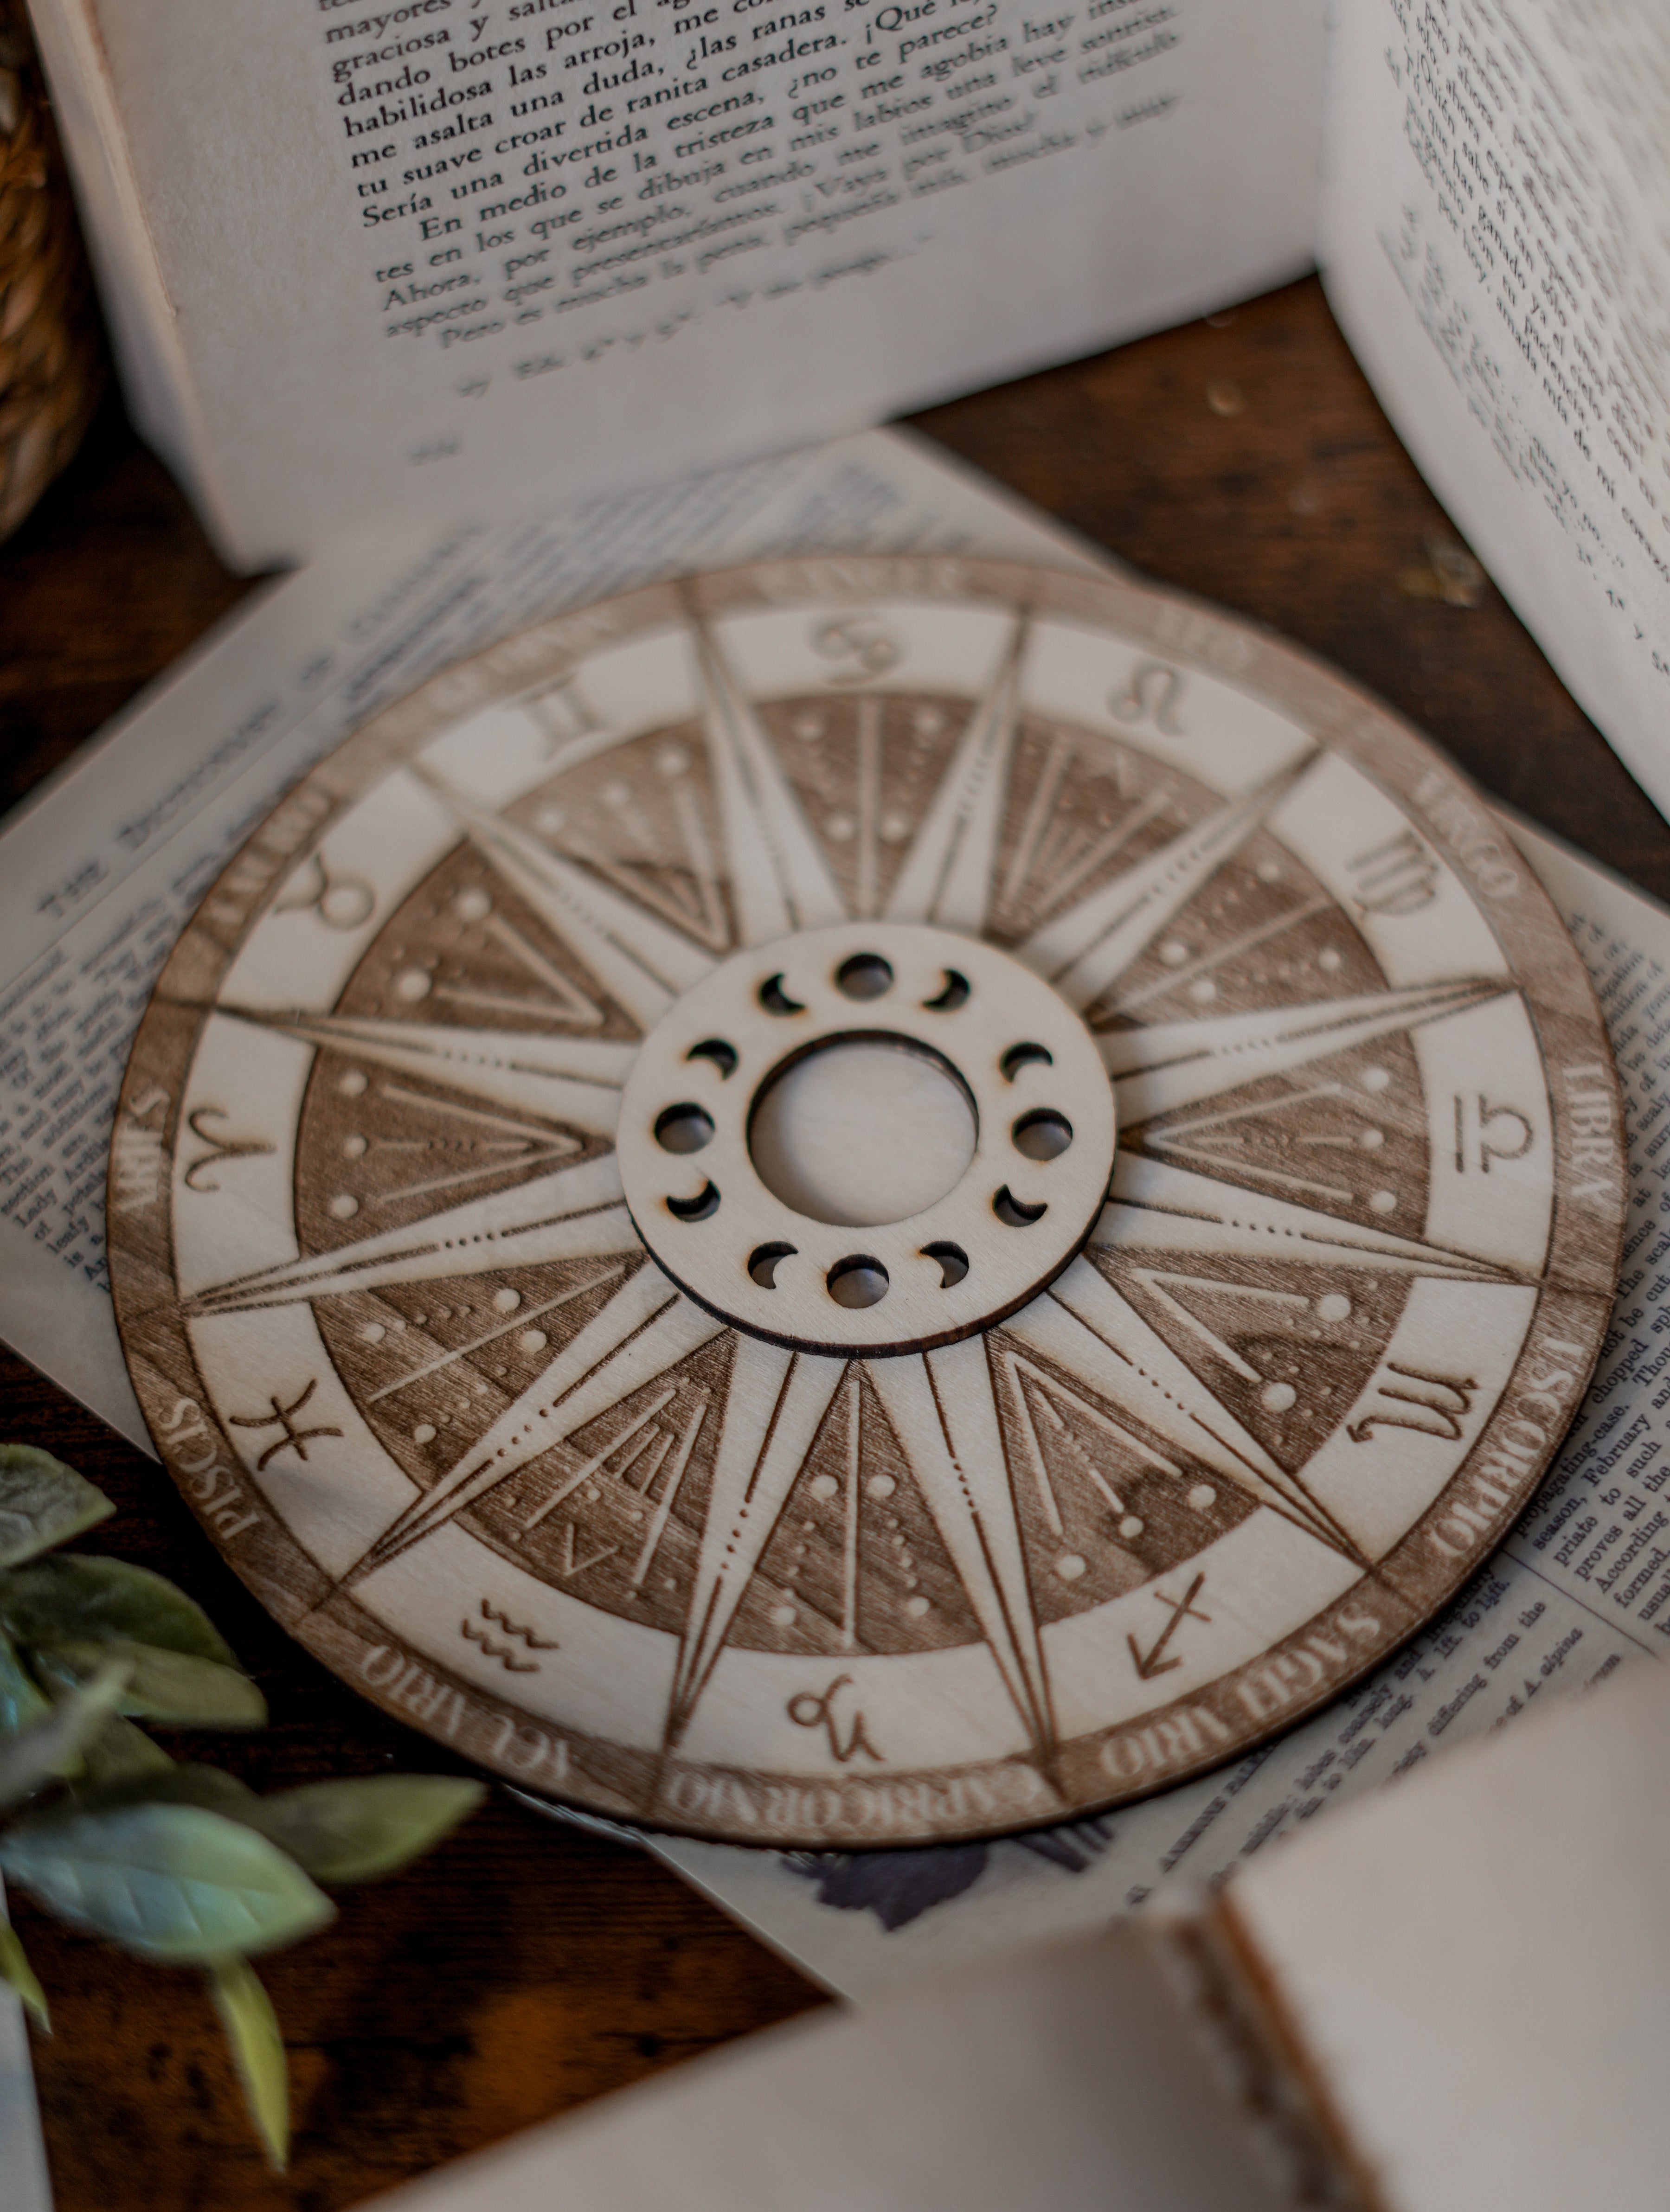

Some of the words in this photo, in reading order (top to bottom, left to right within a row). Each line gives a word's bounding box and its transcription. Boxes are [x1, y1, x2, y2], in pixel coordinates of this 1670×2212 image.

[325, 0, 451, 44] mayores
[332, 29, 451, 83] graciosa
[469, 15, 488, 42] y
[337, 65, 430, 106] dando
[448, 38, 526, 72] botes
[546, 16, 594, 51] por
[613, 0, 636, 20] el
[343, 81, 493, 137] habilidosa
[509, 64, 547, 87] las
[565, 30, 655, 69] arroja,
[674, 8, 718, 34] me
[352, 145, 396, 168] me
[415, 113, 493, 149] asalta
[510, 91, 564, 116] una
[583, 59, 664, 95] duda,
[686, 35, 737, 70] ¿las
[752, 6, 825, 40] ranas
[357, 179, 388, 197] tu
[404, 148, 482, 185] suave
[495, 122, 566, 154] croar
[580, 104, 613, 128] de
[627, 78, 708, 113] ranita
[721, 35, 847, 82] casadera.
[363, 193, 432, 227] Sería
[451, 173, 503, 199] una
[523, 124, 648, 176] divertida
[667, 91, 764, 130] escena,
[788, 67, 837, 99] ¿no
[855, 51, 880, 70] te
[899, 3, 997, 64] parece?
[419, 217, 462, 241] En
[479, 182, 566, 222] medio
[584, 166, 617, 188] de
[633, 152, 657, 172] la
[674, 116, 774, 158] tristeza
[792, 94, 845, 126] que
[861, 75, 903, 99] me
[920, 35, 1015, 82] agobia
[1022, 15, 1074, 43] hay
[375, 263, 414, 282] tes
[429, 248, 462, 266] en
[475, 231, 515, 252] los
[529, 209, 582, 241] que
[597, 197, 623, 214] se
[637, 160, 726, 200] dibuja
[739, 147, 772, 165] en
[789, 124, 839, 152] mis
[853, 96, 932, 131] labios
[946, 73, 996, 100] una
[383, 274, 480, 311] Ahora,
[503, 249, 550, 281] por
[712, 160, 816, 204] cuando
[838, 143, 880, 165] me
[386, 298, 488, 337] aspecto
[502, 275, 555, 307] que
[1478, 205, 1526, 290] ganado
[1570, 364, 1603, 421] cielo
[1497, 297, 1537, 373] amada
[1562, 1065, 1615, 1198] LIBRA
[12, 1189, 58, 1230] Lady
[46, 1216, 90, 1255] leafy
[64, 1251, 84, 1268] is
[1618, 1308, 1643, 1327] be
[1640, 1275, 1670, 1302] cut
[1591, 1338, 1649, 1404] chopped
[158, 1395, 260, 1540] PISCIS
[1430, 1337, 1586, 1557] ESCORPIO
[1532, 1493, 1588, 1552] season,
[1581, 1412, 1651, 1487] February
[1553, 1516, 1598, 1568] priate
[1599, 1488, 1621, 1506] to
[1626, 1442, 1662, 1479] such
[1574, 1526, 1623, 1582] proves
[1623, 1495, 1647, 1521] all
[1642, 1466, 1670, 1493] the
[1594, 1510, 1670, 1594] According
[1394, 1648, 1423, 1680] and
[1427, 1673, 1488, 1738] differing
[1483, 1634, 1521, 1670] from
[1518, 1602, 1546, 1629] the
[1459, 1611, 1480, 1628] to
[1540, 1628, 1583, 1678] alpina
[358, 1644, 572, 1780] ACUARIO
[1099, 1603, 1381, 1777] SAGITARIO
[667, 1763, 1043, 1827] CAPRICORNIO
